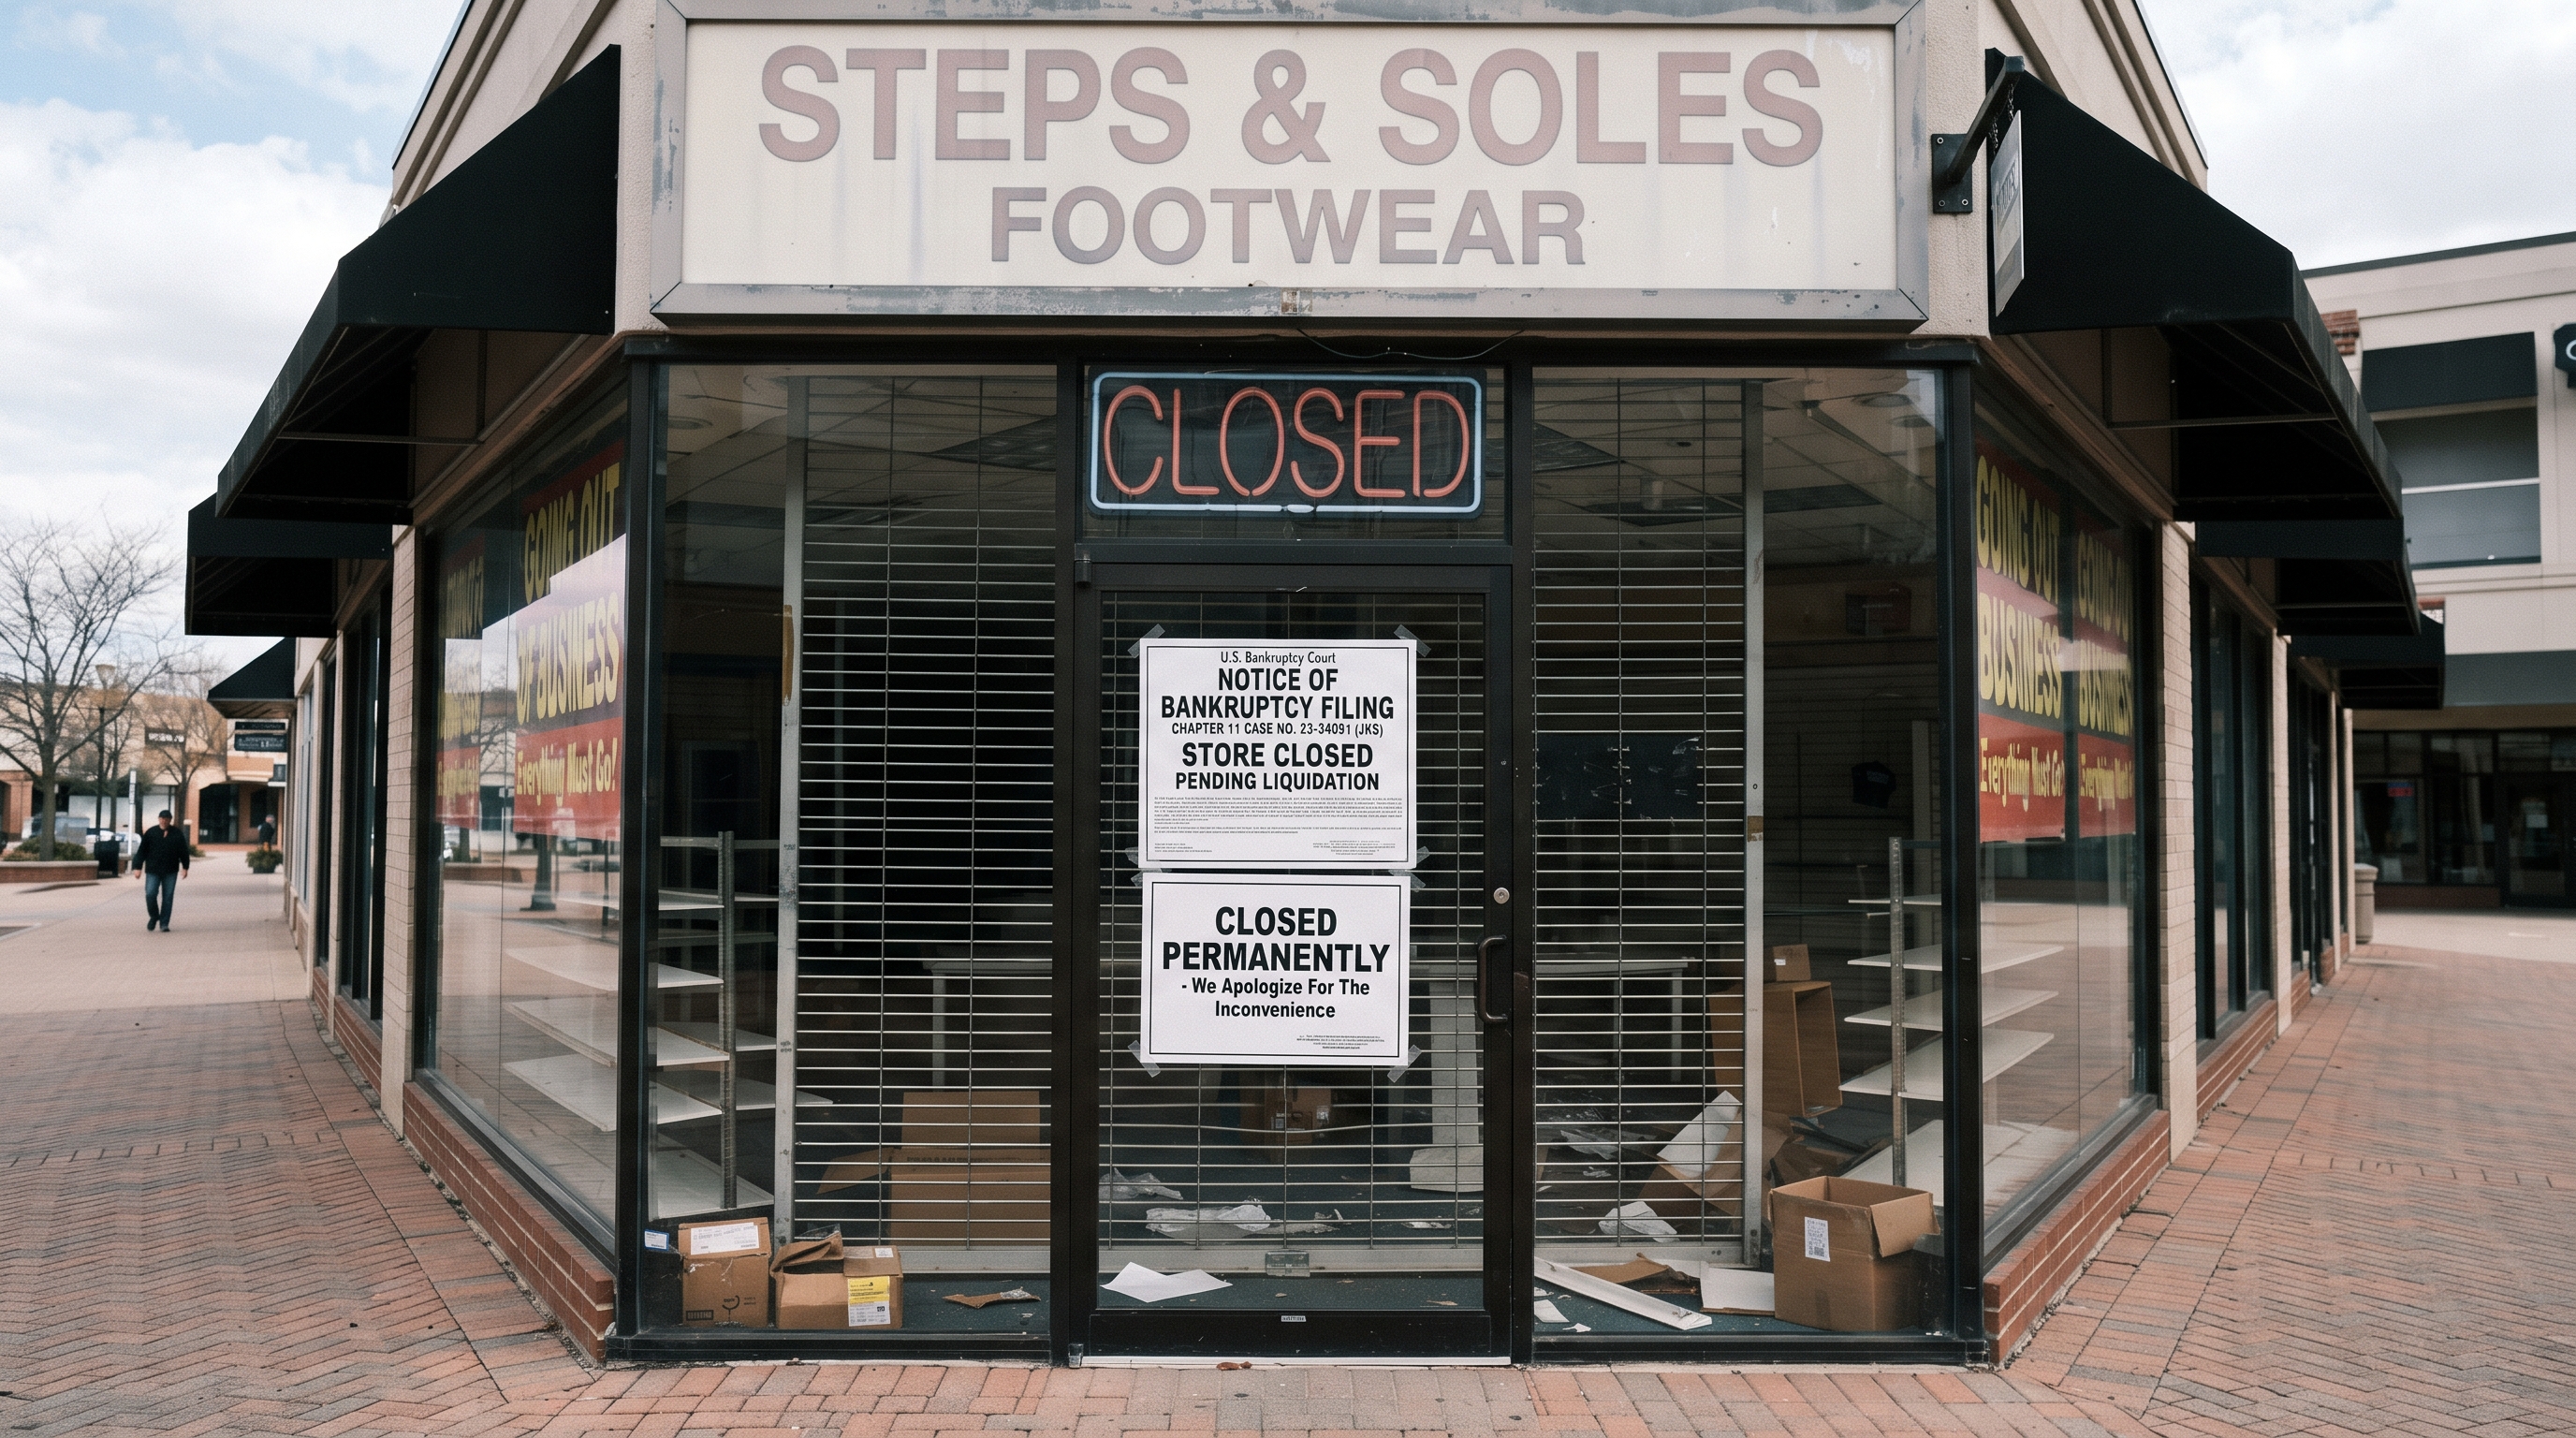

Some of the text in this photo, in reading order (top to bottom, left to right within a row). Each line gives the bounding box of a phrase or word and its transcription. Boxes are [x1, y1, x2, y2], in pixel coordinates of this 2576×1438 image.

[759, 45, 1824, 167] STEPS & SOLES
[991, 185, 1587, 265] FOOTWEAR
[1104, 385, 1470, 497] CLOSED
[524, 489, 575, 605] GOING
[579, 462, 620, 564] OUT
[1976, 455, 2059, 605] GOING OUT
[517, 624, 536, 726] OF
[536, 592, 620, 720] BUSINESS
[1222, 651, 1336, 667] U.S. Bankruptcy Court
[1979, 592, 2062, 720] BUSINESS
[1219, 668, 1338, 691] NOTICE OF
[1162, 696, 1393, 719] BANKRUPTCY FILING
[1172, 723, 1383, 738] CHAPTER 11 CASE NO. 23-34091 (JKS)
[1182, 742, 1372, 767] STORE CLOSED
[517, 743, 565, 808] Everything
[567, 741, 593, 796] Must
[595, 738, 618, 793] Go!
[1177, 772, 1379, 792] PENDING LIQUIDATION
[1980, 738, 2030, 813] Everything
[1216, 906, 1337, 936] CLOSED
[1164, 942, 1390, 972] PERMANENTLY
[1193, 977, 1216, 993] We
[1222, 978, 1302, 998] Apologize
[1309, 978, 1334, 994] For
[1339, 979, 1369, 995] The
[1216, 1001, 1335, 1018] Inconvenience
